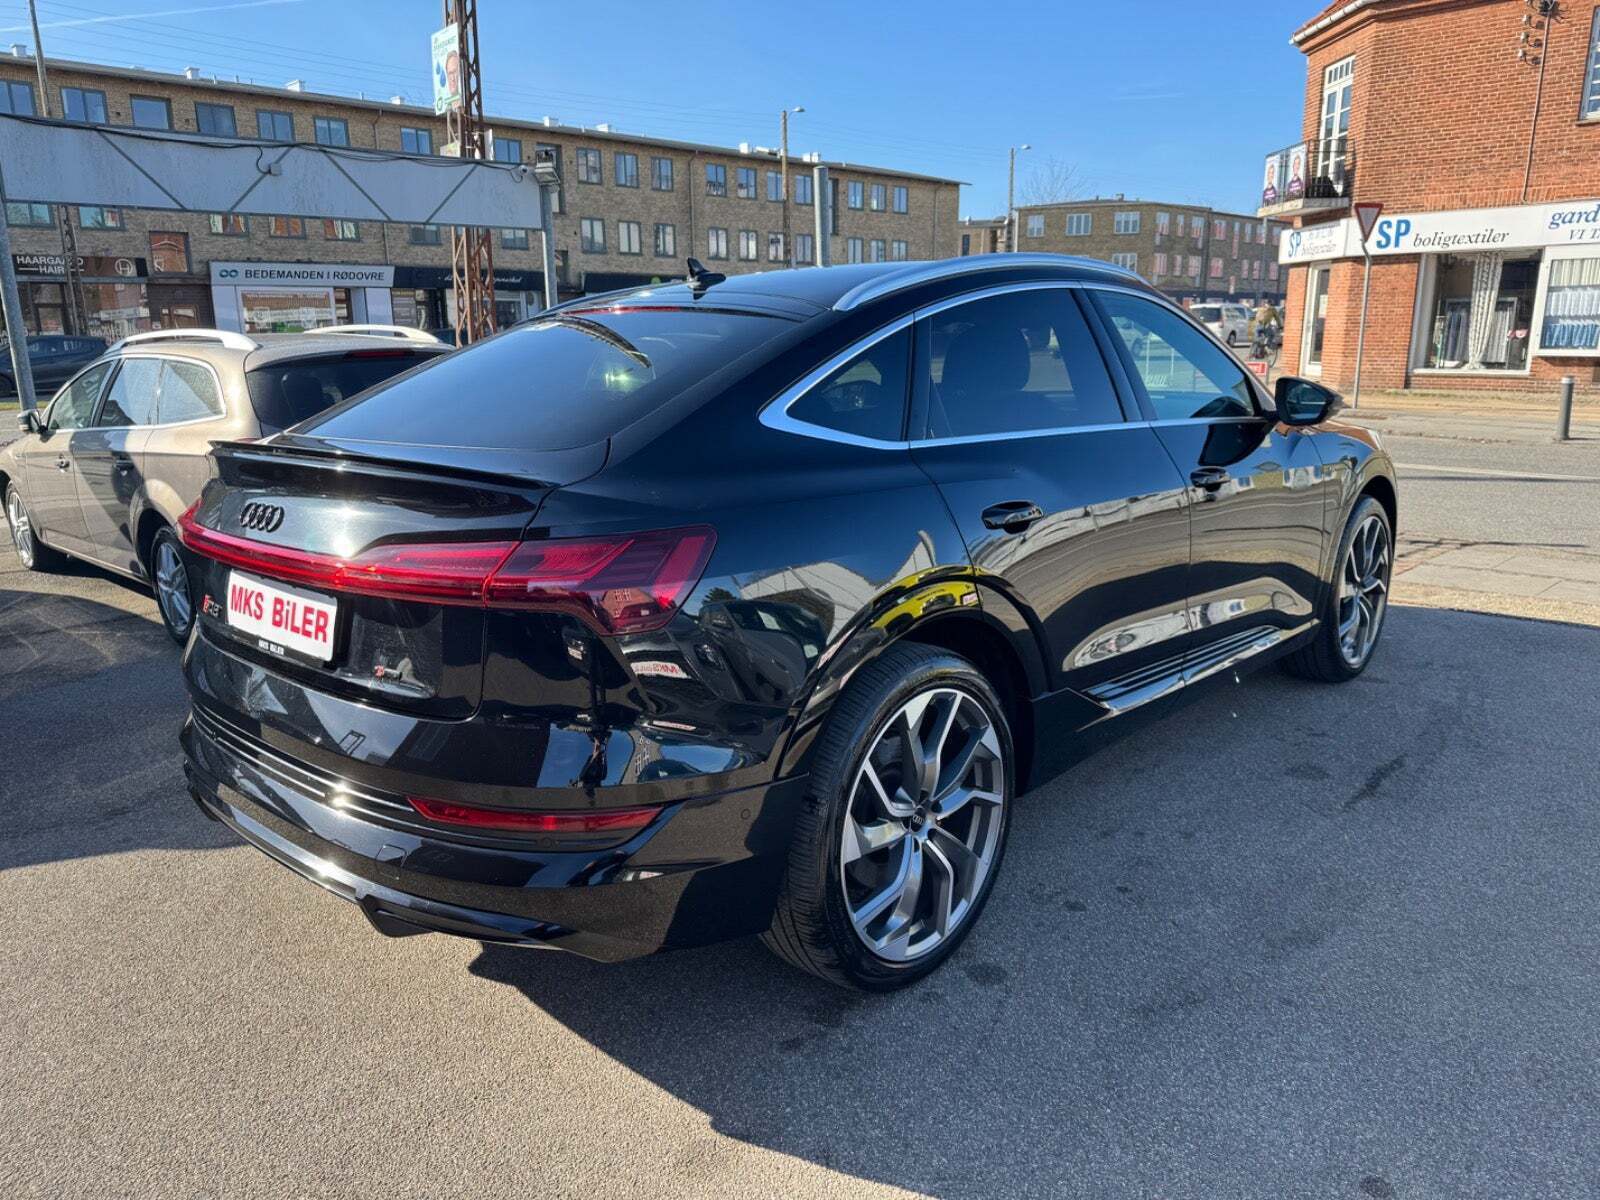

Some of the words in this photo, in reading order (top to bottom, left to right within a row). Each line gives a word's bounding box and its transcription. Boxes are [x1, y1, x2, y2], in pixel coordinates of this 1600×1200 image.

[1376, 219, 1411, 249] SP
[1413, 228, 1510, 248] boligtextiler
[1288, 231, 1302, 257] SP
[16, 255, 84, 266] HAARGAD
[39, 265, 65, 275] HAIR
[244, 269, 324, 280] BEDEMANDEN
[326, 271, 330, 280] I
[333, 271, 385, 281] RØDOVRE
[230, 584, 264, 621] MKS
[271, 597, 329, 643] BiLER
